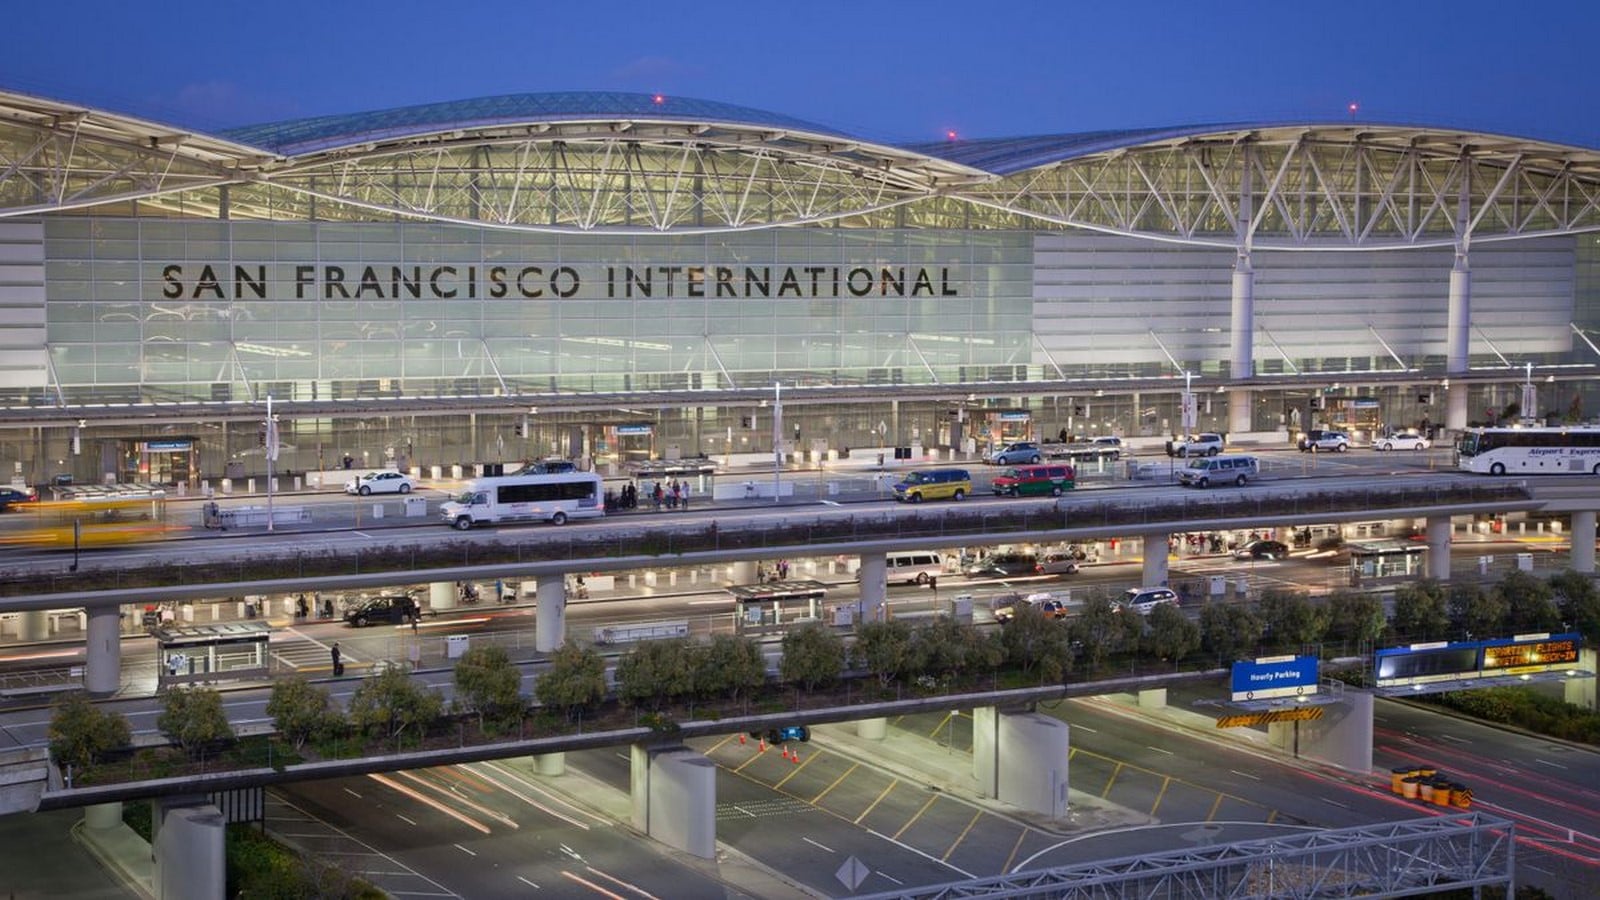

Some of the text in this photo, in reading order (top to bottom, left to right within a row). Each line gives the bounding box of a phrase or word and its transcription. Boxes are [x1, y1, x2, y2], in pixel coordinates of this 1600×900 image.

[162, 264, 958, 299] SAN FRANCISCO INTERNATIONAL
[1528, 448, 1564, 456] Airport
[1532, 650, 1576, 663] HECK-IN
[1250, 670, 1301, 681] Hourly Parking
